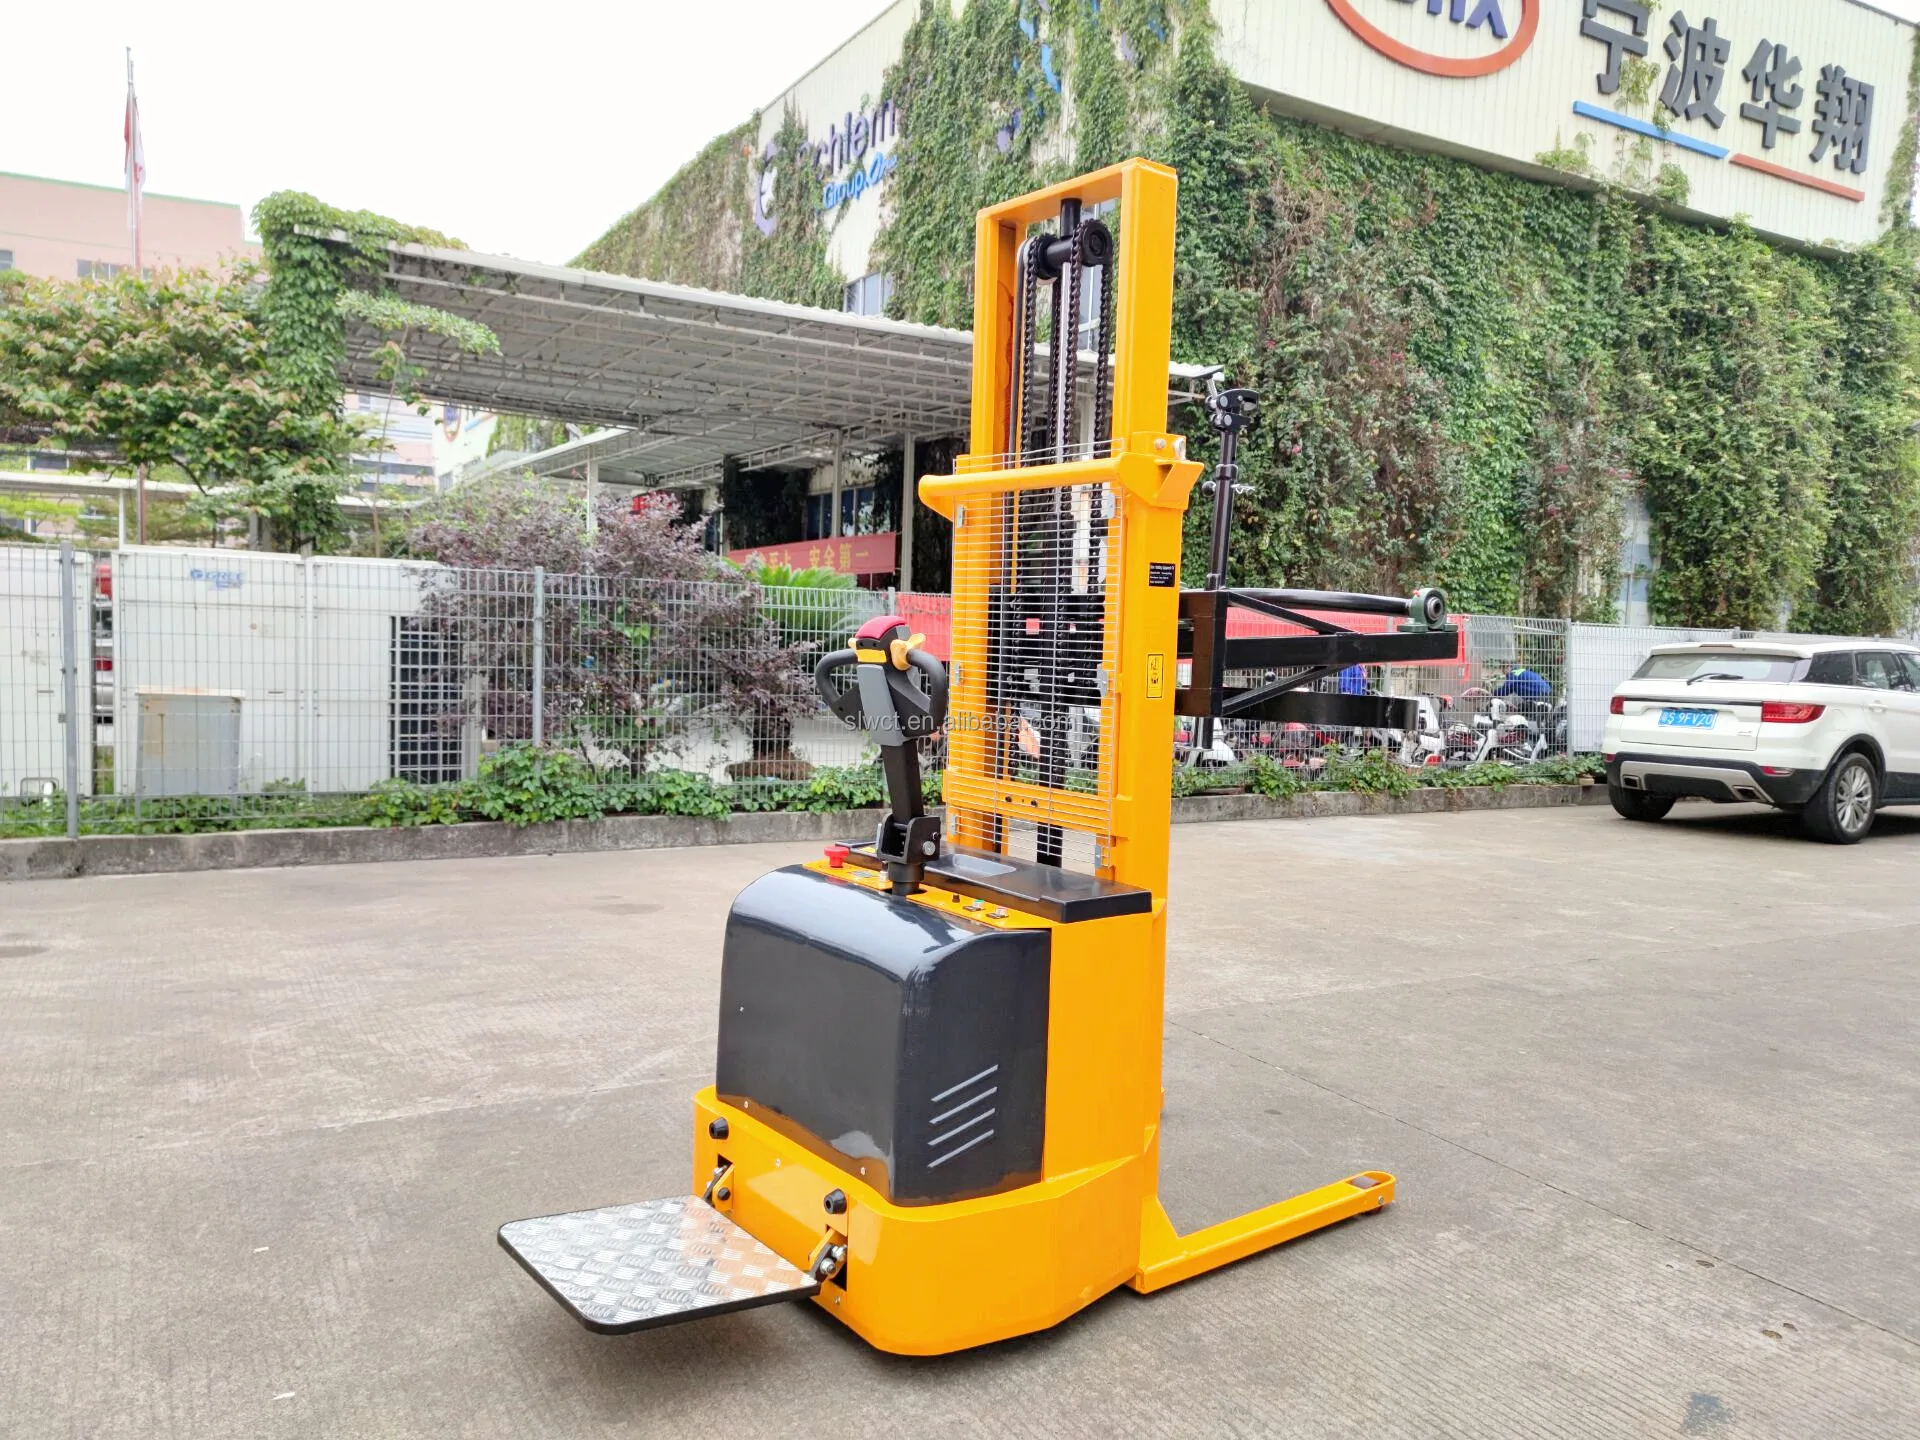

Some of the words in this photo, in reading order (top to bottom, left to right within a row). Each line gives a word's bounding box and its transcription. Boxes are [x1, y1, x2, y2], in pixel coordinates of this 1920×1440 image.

[1580, 0, 1875, 174] 宁波华翔
[809, 543, 869, 571] 安全第一
